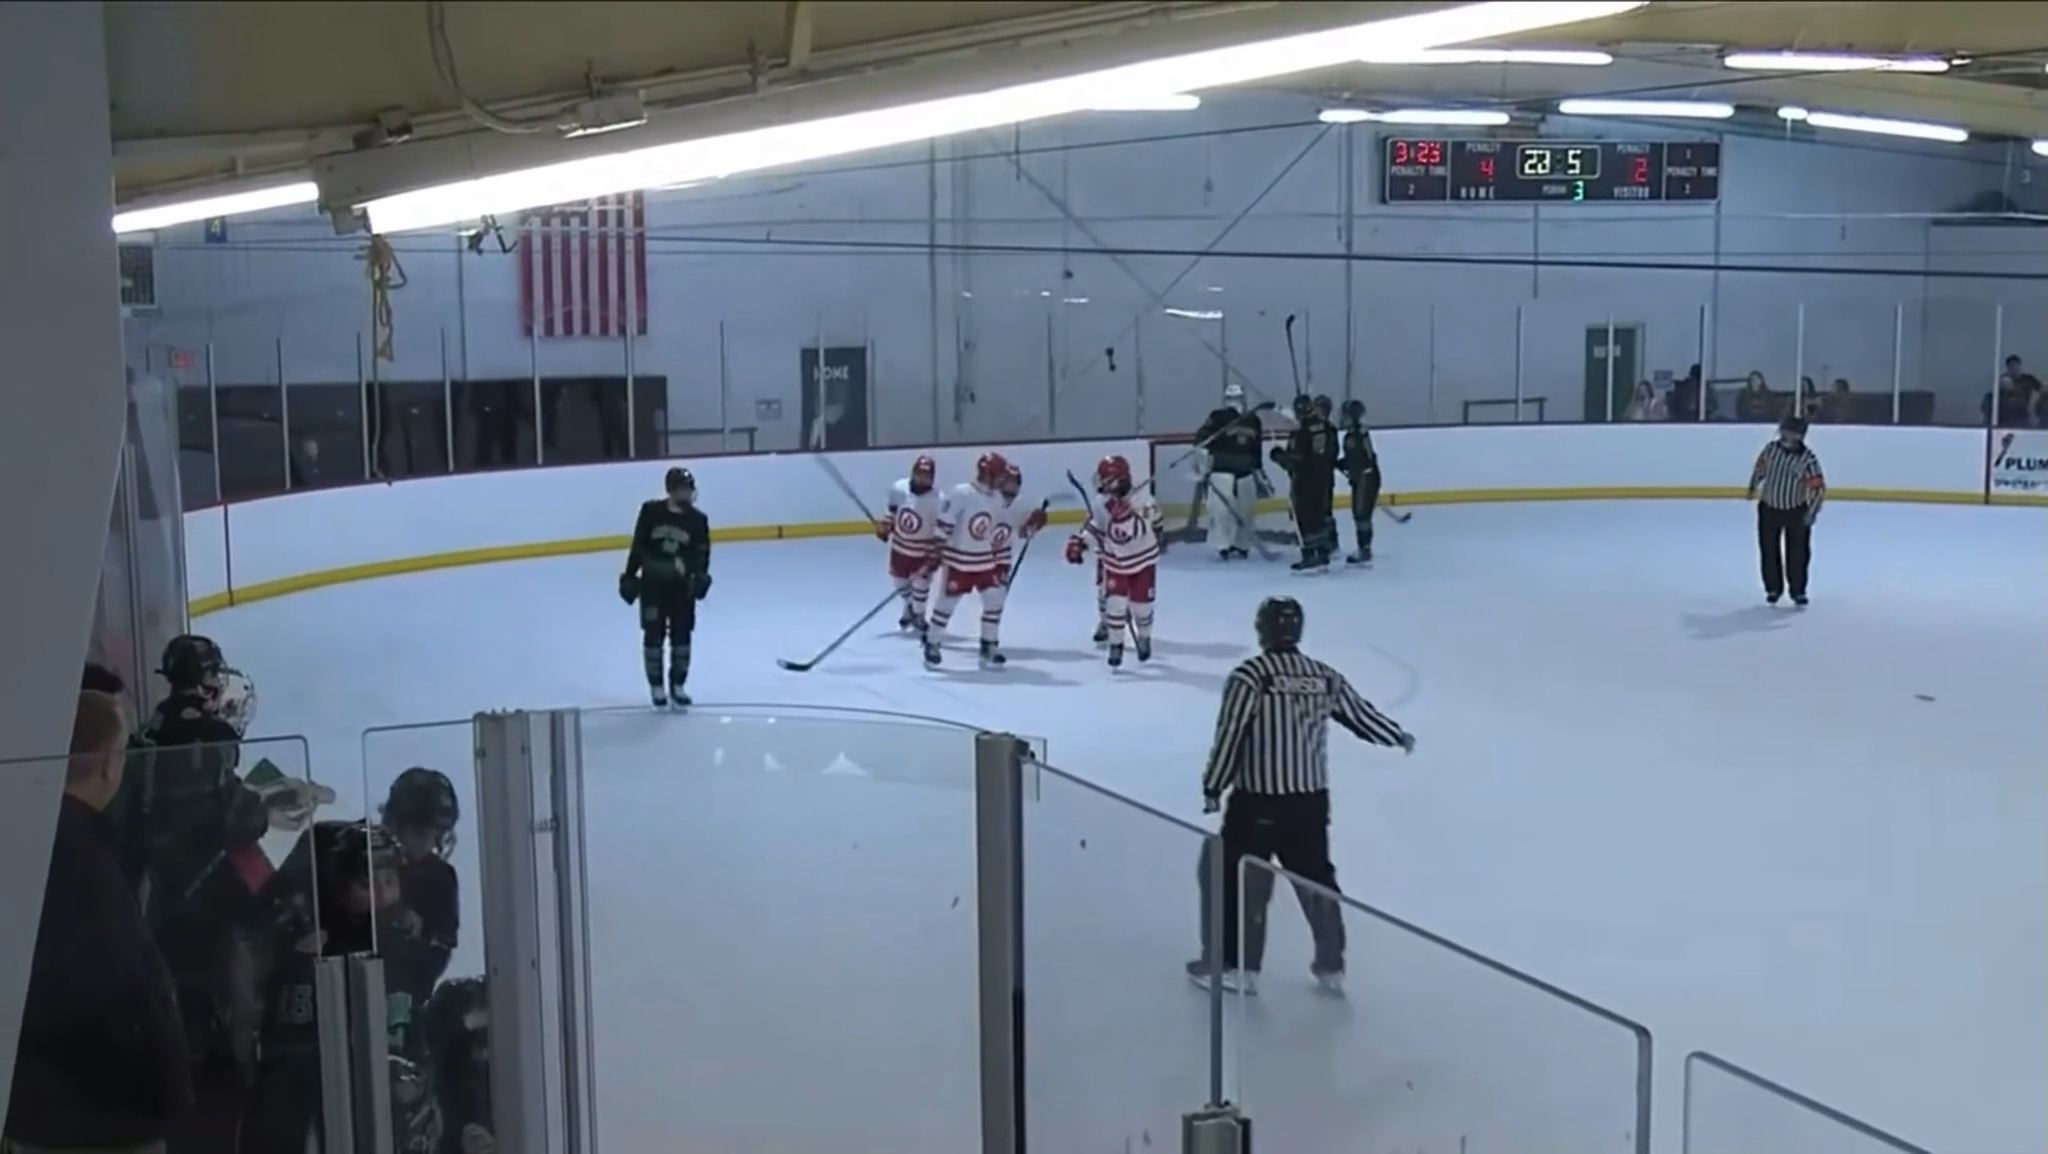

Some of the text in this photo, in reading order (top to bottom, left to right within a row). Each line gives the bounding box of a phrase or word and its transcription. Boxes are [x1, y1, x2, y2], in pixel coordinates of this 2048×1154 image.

[1480, 158, 1495, 175] 4
[1633, 157, 1648, 182] 2
[1460, 186, 1495, 199] HOME
[1574, 181, 1584, 201] 3
